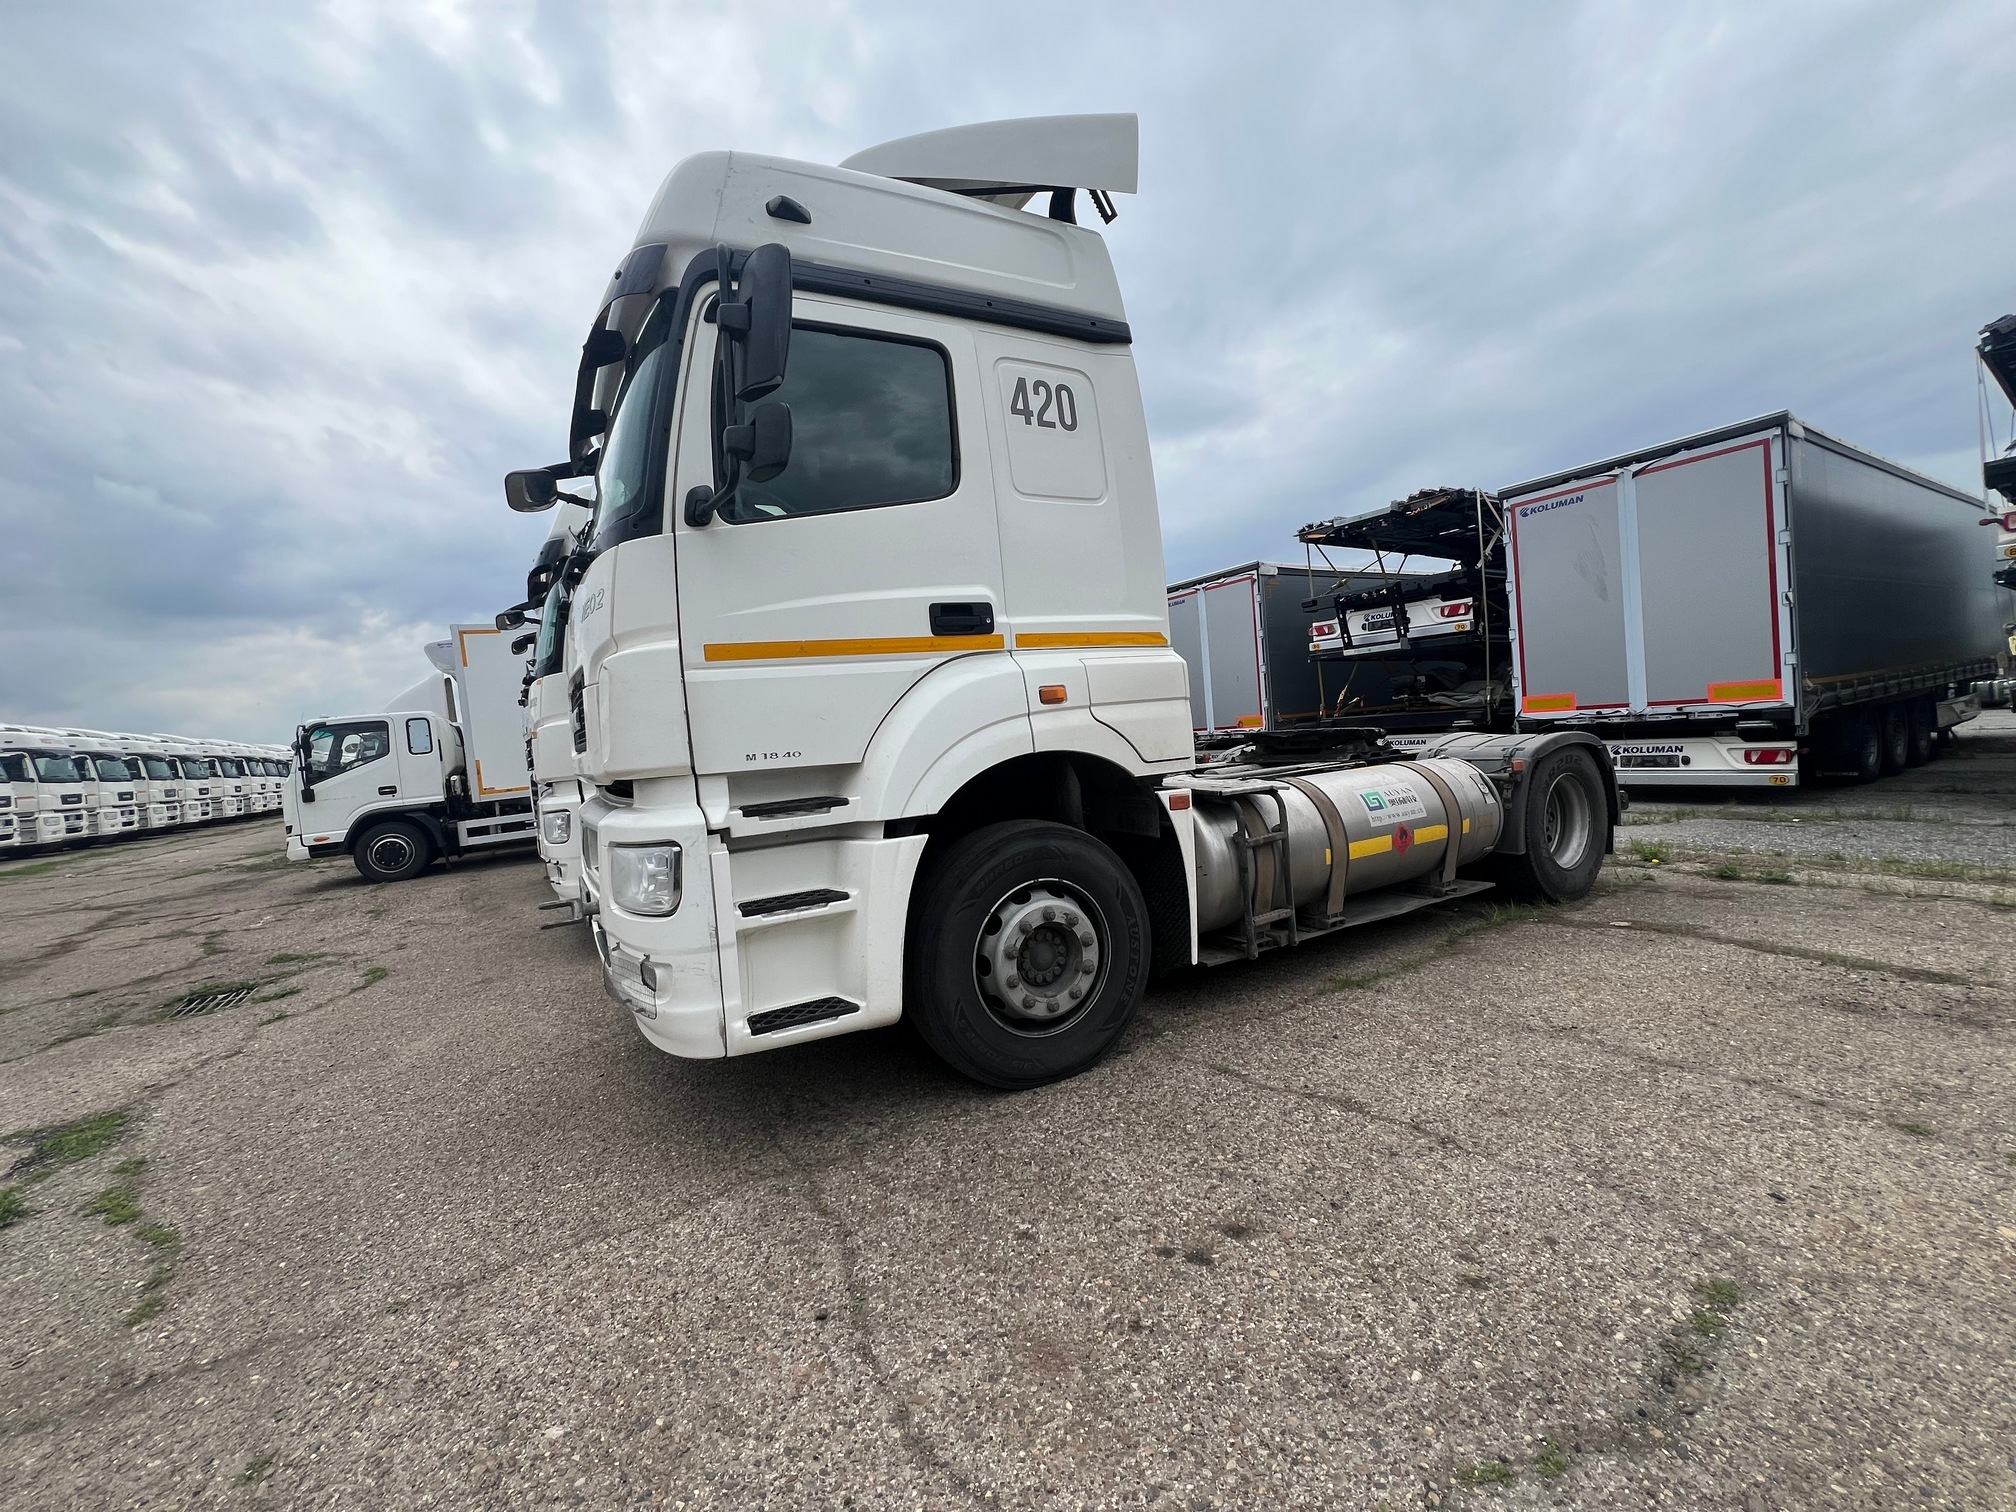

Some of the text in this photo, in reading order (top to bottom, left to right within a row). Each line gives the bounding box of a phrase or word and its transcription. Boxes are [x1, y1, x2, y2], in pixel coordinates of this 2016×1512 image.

[1010, 376, 1078, 433] 420
[1530, 495, 1584, 515] KOLUMAN
[745, 753, 757, 761] M
[1622, 745, 1684, 754] KOLUMAN
[1119, 914, 1140, 1006] AUSTONE
